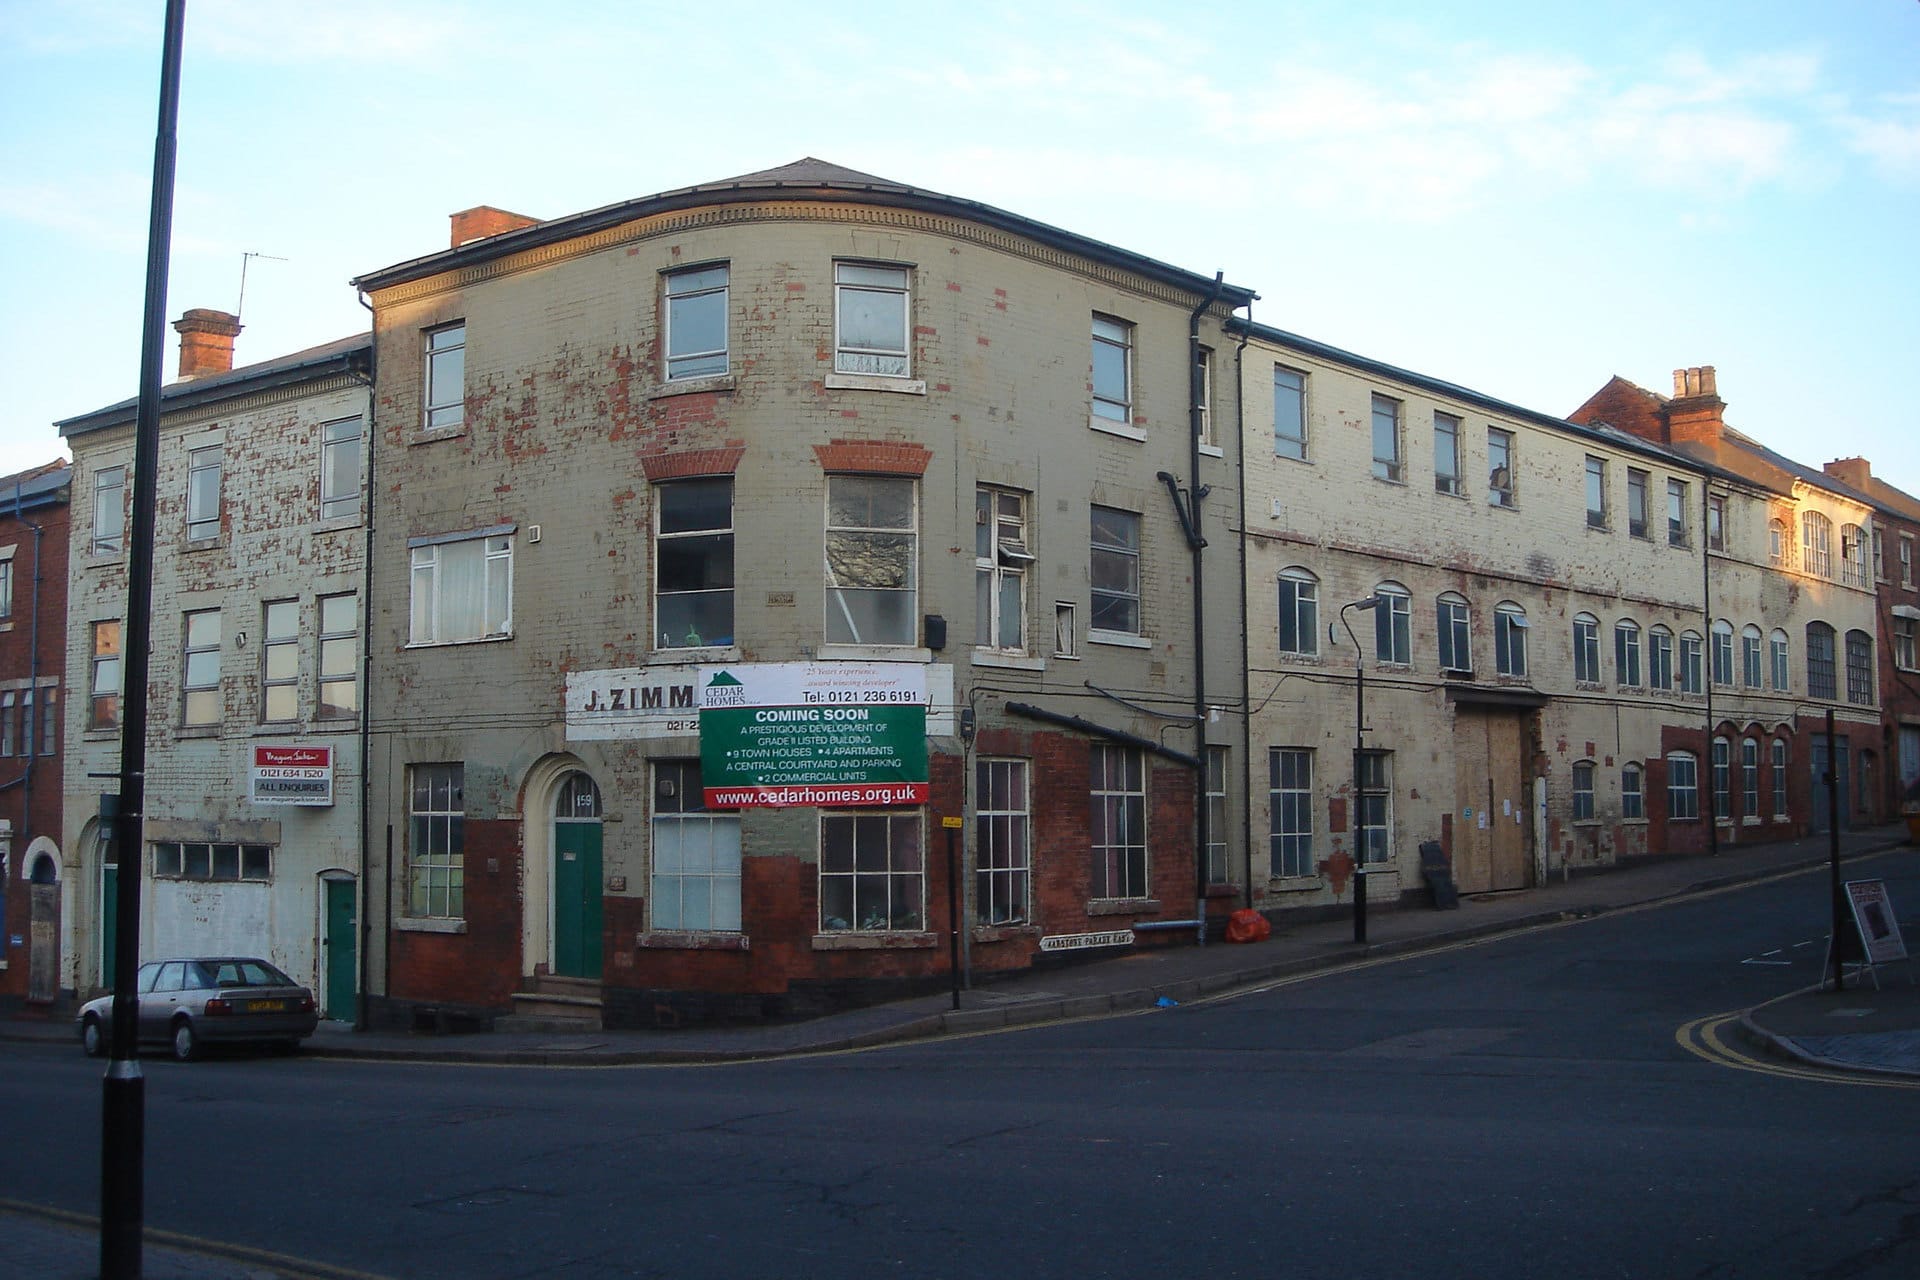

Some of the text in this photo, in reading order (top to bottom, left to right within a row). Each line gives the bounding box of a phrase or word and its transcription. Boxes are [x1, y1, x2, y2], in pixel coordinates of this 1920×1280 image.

[818, 667, 836, 675] Years
[705, 687, 744, 697] CEDAR
[802, 691, 917, 702] Tel: 0121 236 6191
[706, 696, 746, 706] HOMES
[756, 708, 869, 722] COMING SOON
[740, 723, 888, 735] A PRESTIGIOUS DEVELOPMENT OF
[757, 737, 790, 746] GRADE
[797, 736, 828, 745] LISTED
[829, 735, 872, 744] BUILDING
[741, 749, 771, 758] TOWN
[772, 747, 812, 757] HOUSES
[832, 746, 894, 756] APARTMENTS
[726, 758, 902, 771] A CENTRAL COURTYARD AND PARKING
[261, 769, 324, 778] 0121 634 1520
[764, 771, 867, 782] 2 COMMERCIAL UNITS
[260, 783, 324, 792] ALL ENQUIRIES
[577, 794, 592, 806] 159
[715, 785, 916, 805] www.cedarhomes.org.uk
